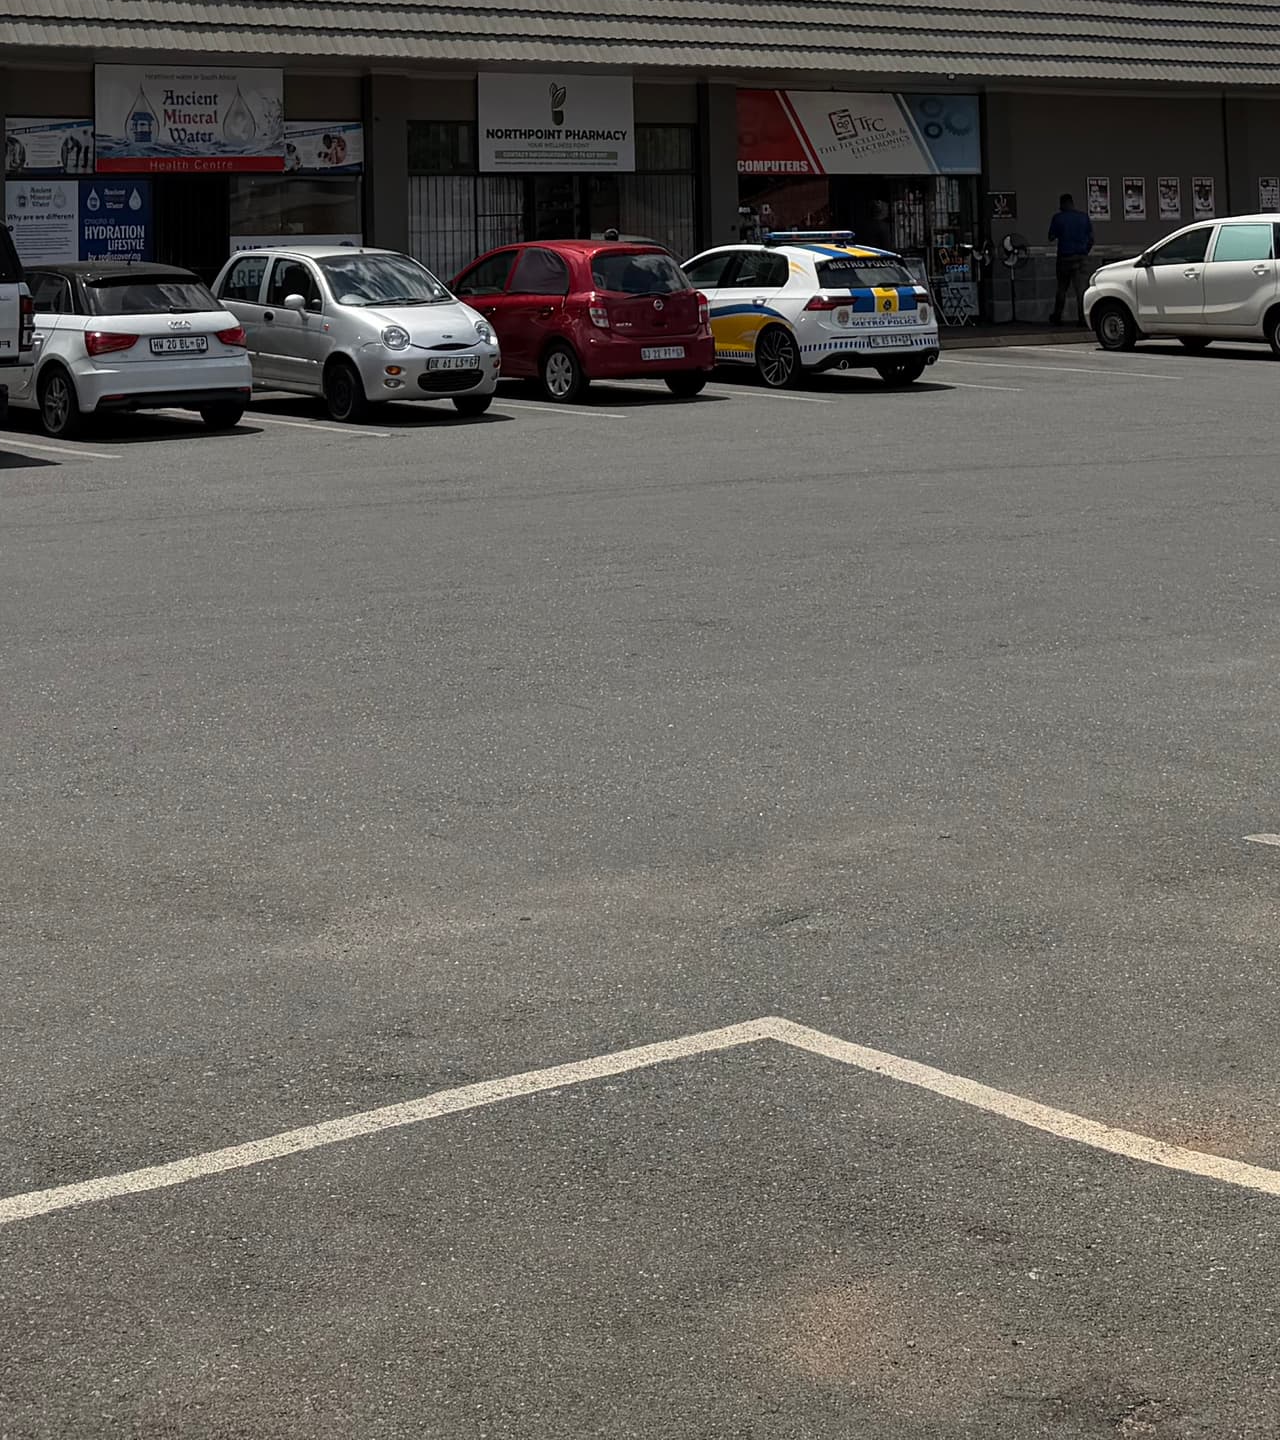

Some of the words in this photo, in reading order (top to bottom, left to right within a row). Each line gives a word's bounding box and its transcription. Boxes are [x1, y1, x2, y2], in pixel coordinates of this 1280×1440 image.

[163, 89, 218, 105] Ancient
[163, 109, 218, 126] Mineral
[854, 116, 887, 132] TFC
[168, 128, 214, 143] Water
[486, 128, 562, 140] NORTHPOINT
[565, 129, 627, 141] PHARMACY
[150, 159, 189, 171] Health
[194, 159, 233, 170] Centre
[736, 160, 808, 172] COMPUTERS
[7, 213, 21, 222] Why
[84, 225, 145, 240] HYDRATION
[108, 239, 144, 251] LIFESTYLE
[828, 259, 864, 271] METRO
[866, 259, 899, 268] POLICE
[887, 319, 917, 327] POLICE
[154, 341, 164, 350] HW
[167, 340, 176, 349] 20
[196, 338, 205, 348] GP
